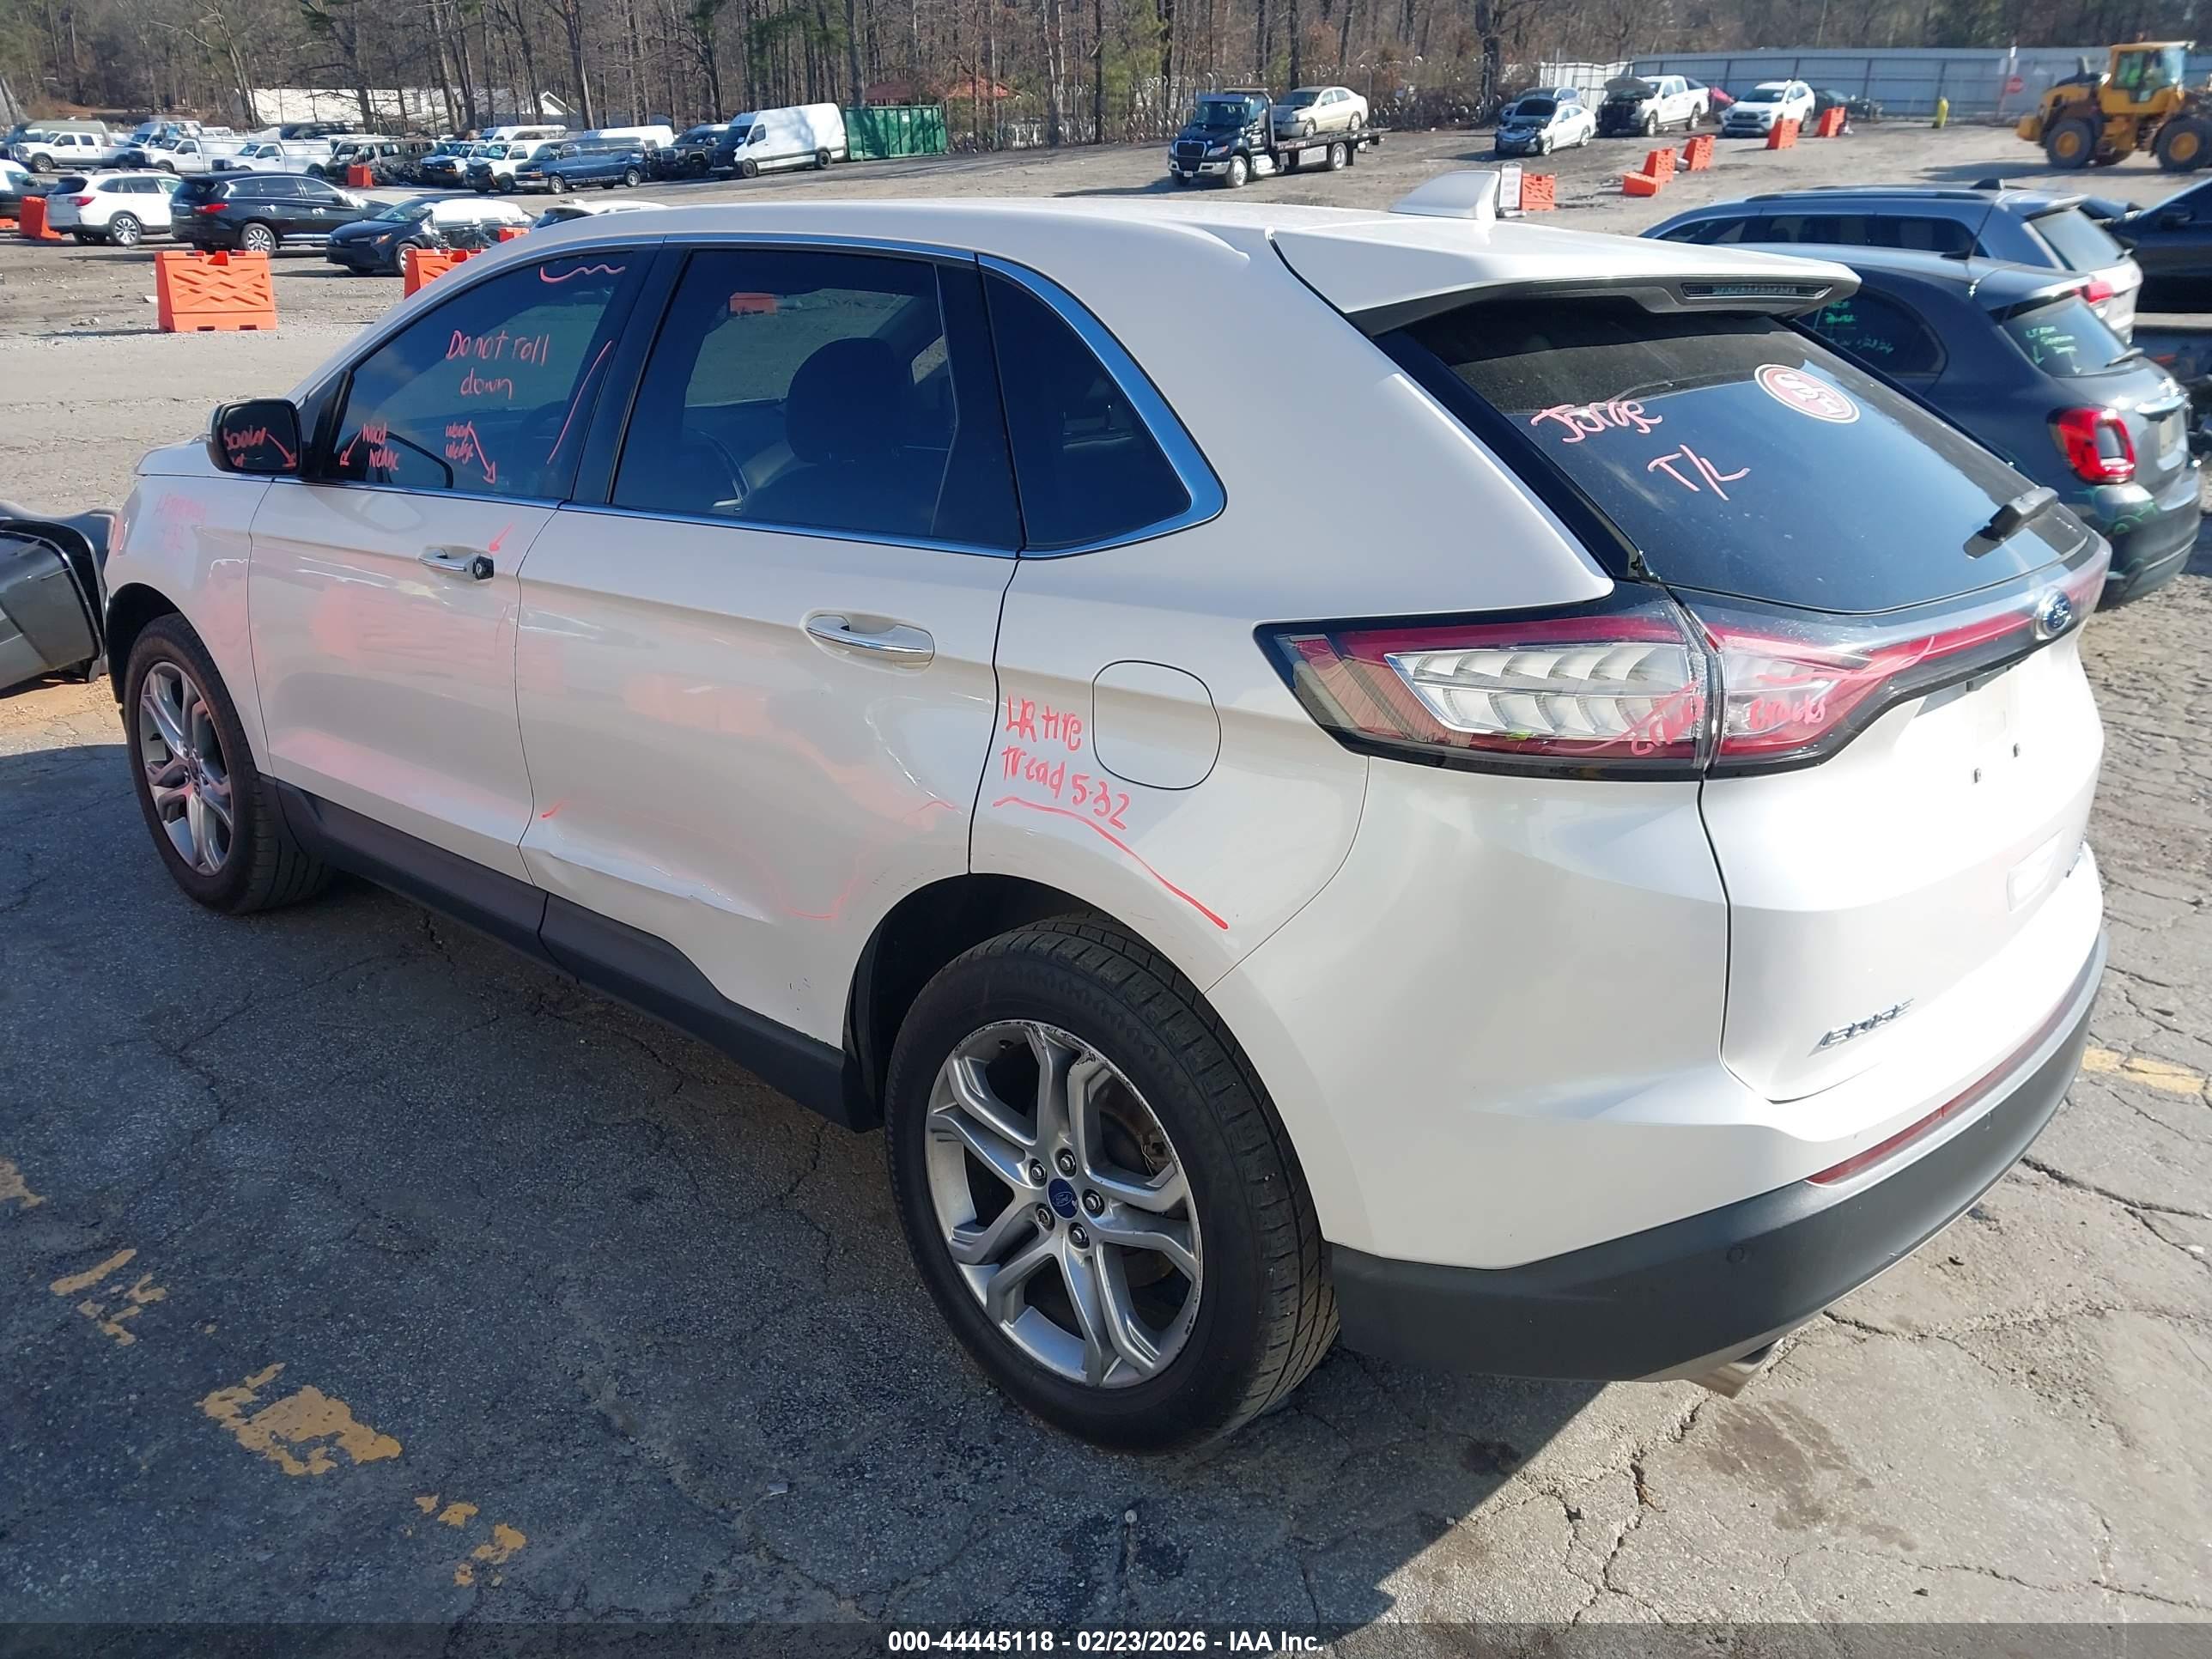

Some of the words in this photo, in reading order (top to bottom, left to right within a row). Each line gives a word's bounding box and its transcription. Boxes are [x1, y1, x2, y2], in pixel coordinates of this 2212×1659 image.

[446, 330, 471, 360] Do
[473, 330, 509, 360] not
[512, 333, 550, 367] roll
[459, 367, 513, 400] down
[1647, 444, 1752, 501] T/L
[1006, 695, 1037, 743] LR
